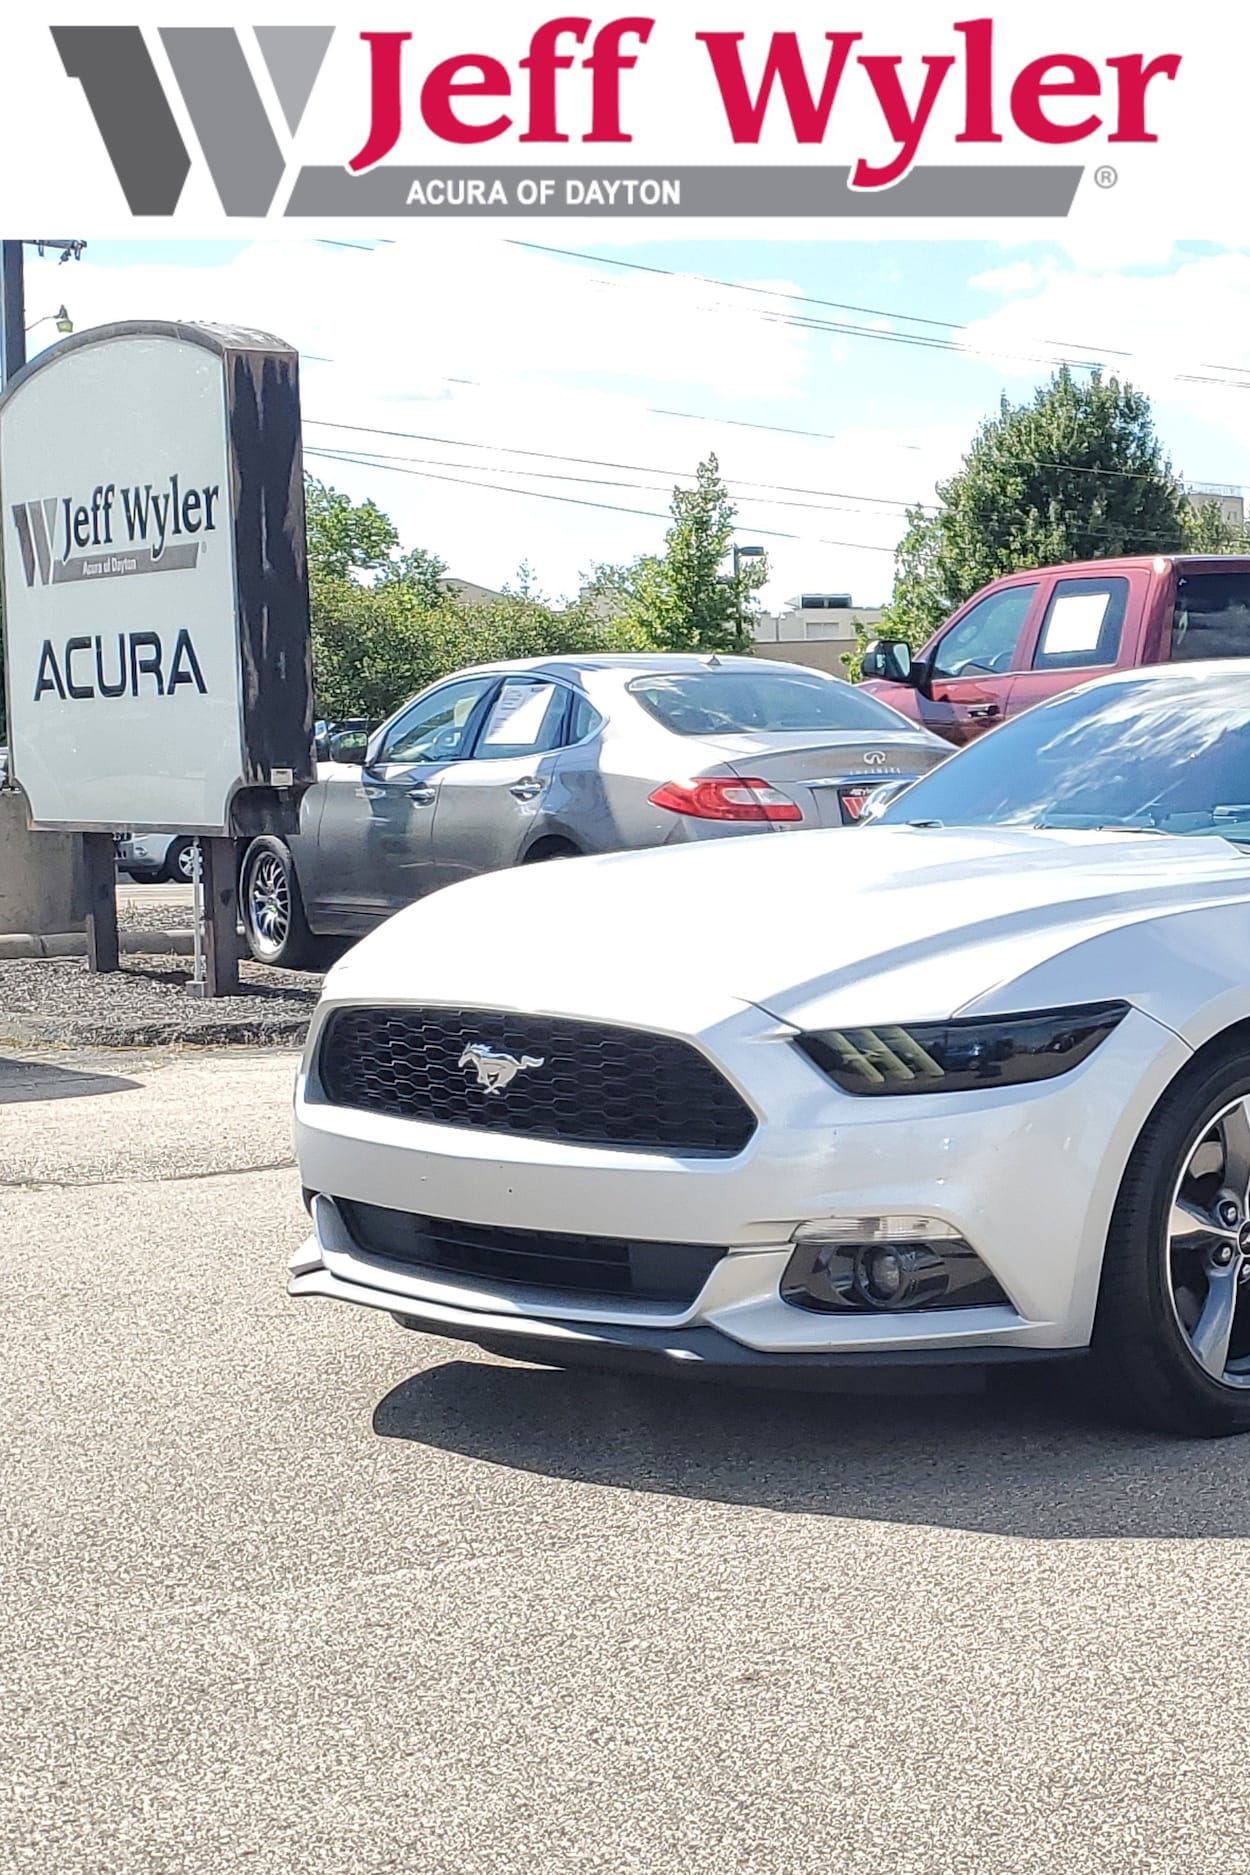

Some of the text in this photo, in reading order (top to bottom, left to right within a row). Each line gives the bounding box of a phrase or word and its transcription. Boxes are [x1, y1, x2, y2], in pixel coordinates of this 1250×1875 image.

[61, 473, 219, 562] Jeff Wyler
[33, 628, 208, 701] ACURA
